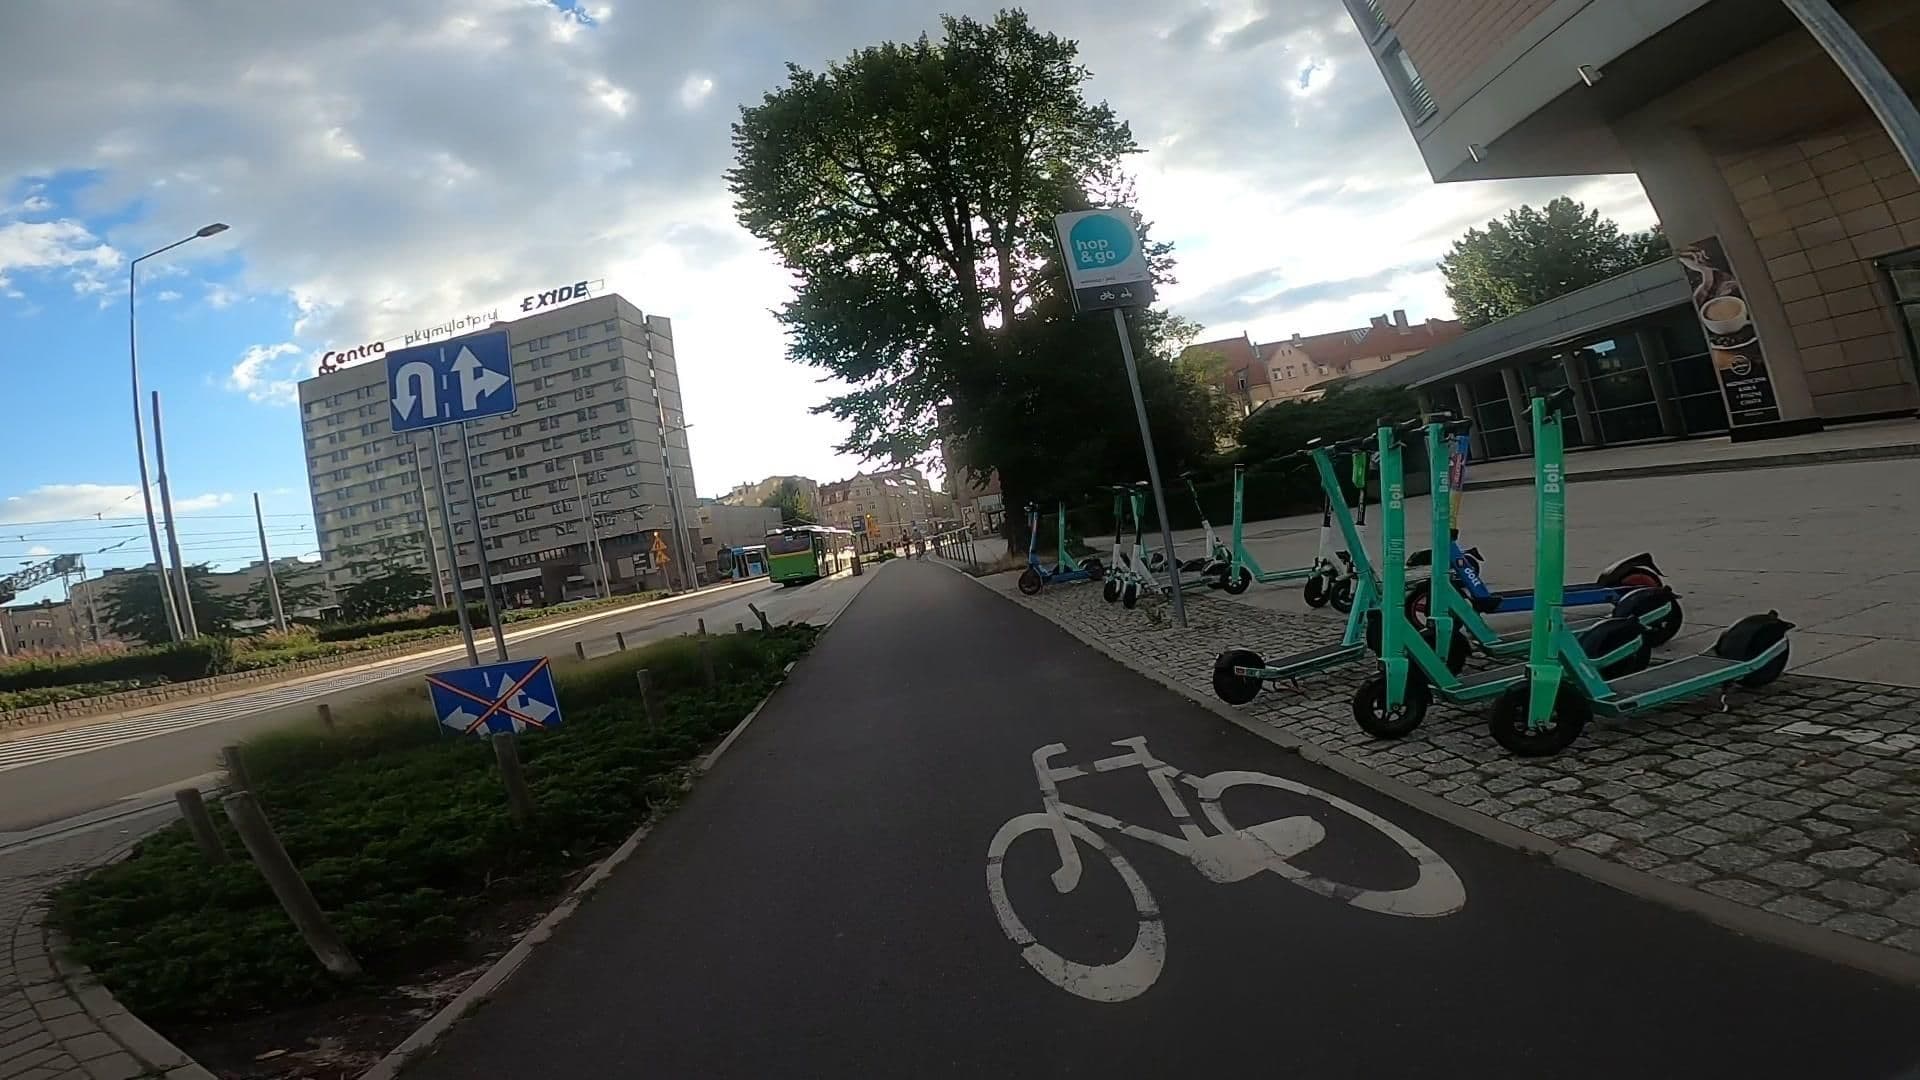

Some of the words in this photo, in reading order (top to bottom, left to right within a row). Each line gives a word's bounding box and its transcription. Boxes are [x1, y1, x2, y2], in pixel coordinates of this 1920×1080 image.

[1076, 239, 1108, 251] hop
[322, 341, 385, 369] Centra
[520, 280, 588, 312] EXIDE
[1542, 463, 1560, 493] Bolt
[1388, 483, 1402, 510] Bolt
